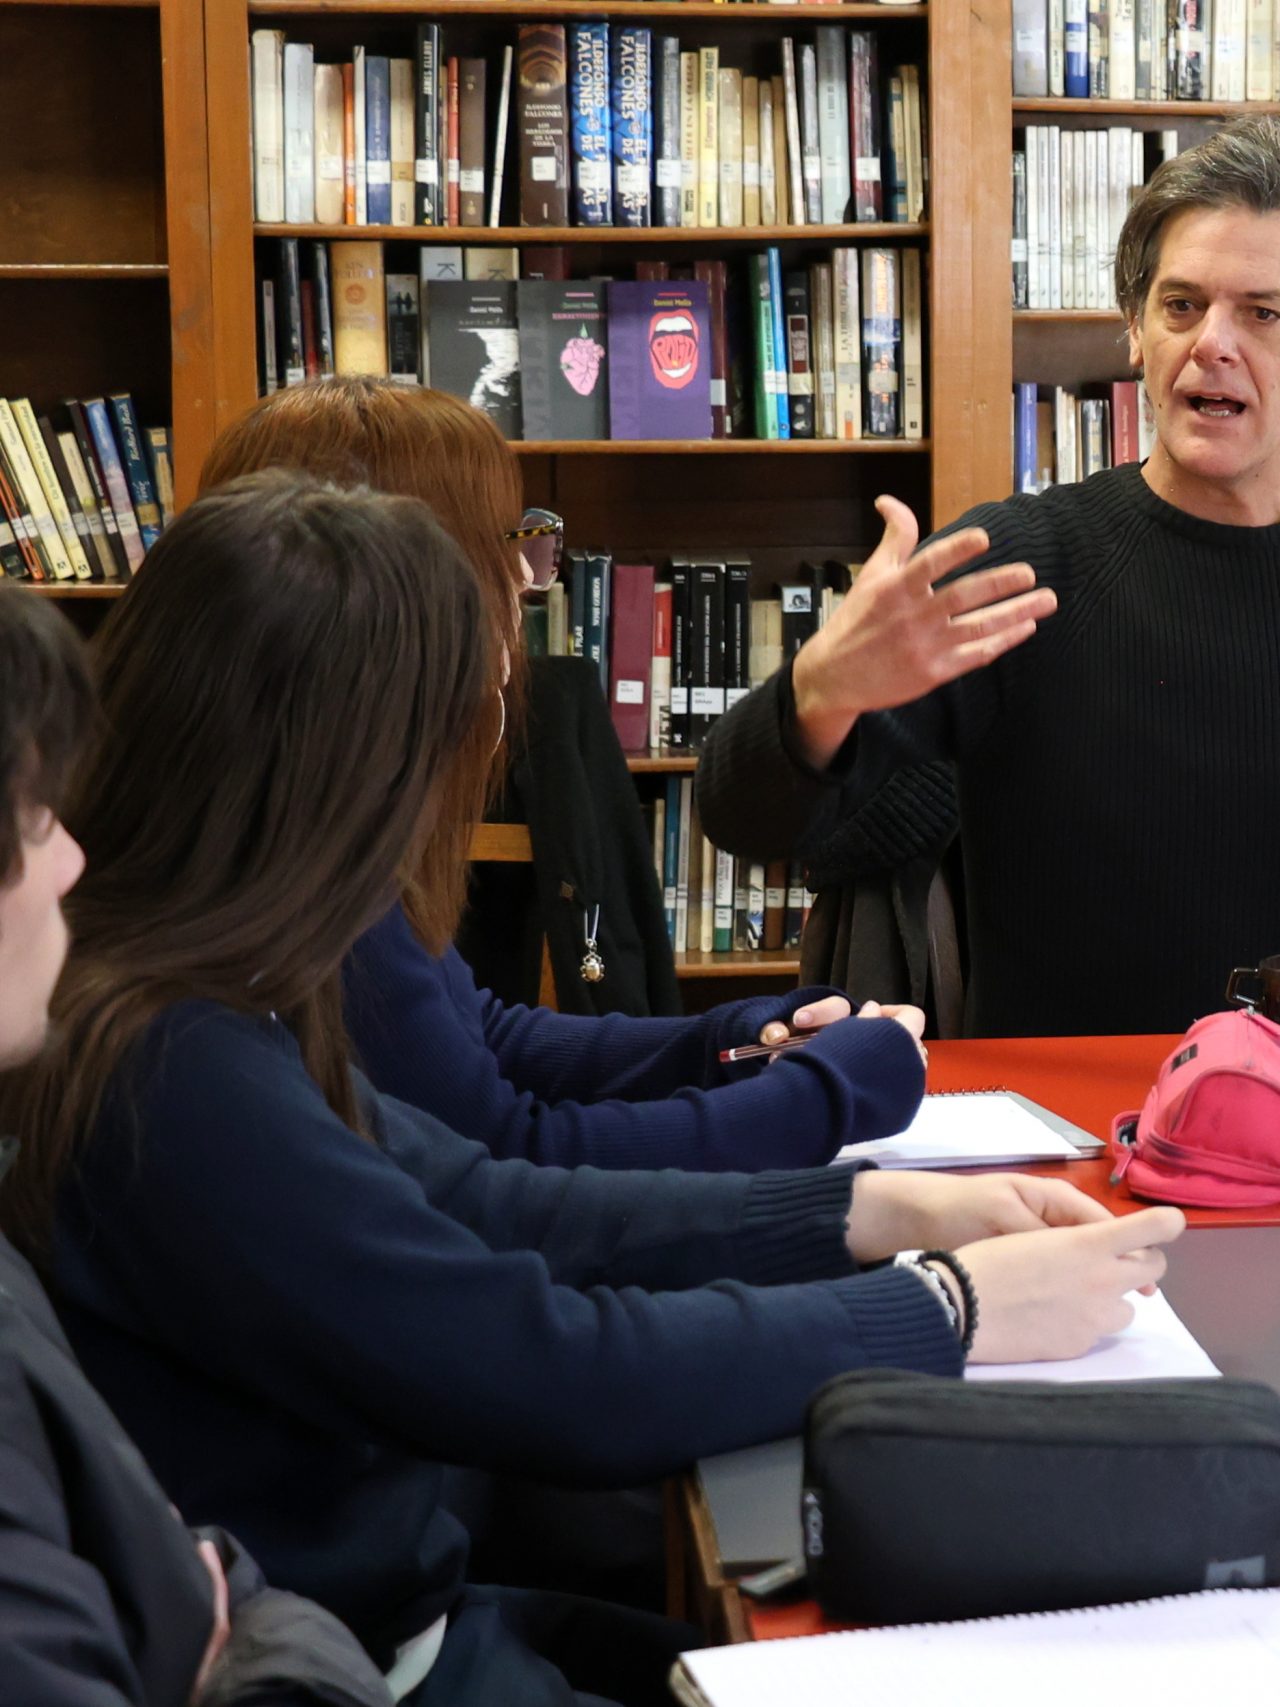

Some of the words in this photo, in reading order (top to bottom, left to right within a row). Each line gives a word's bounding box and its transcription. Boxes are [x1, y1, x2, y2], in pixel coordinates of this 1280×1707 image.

[578, 31, 593, 116] FALCONES
[593, 39, 605, 107] ILDEFONSO
[621, 35, 635, 119] FALCONES
[634, 43, 646, 111] ILDEFONSO
[581, 135, 593, 151] DE
[622, 138, 634, 154] DE
